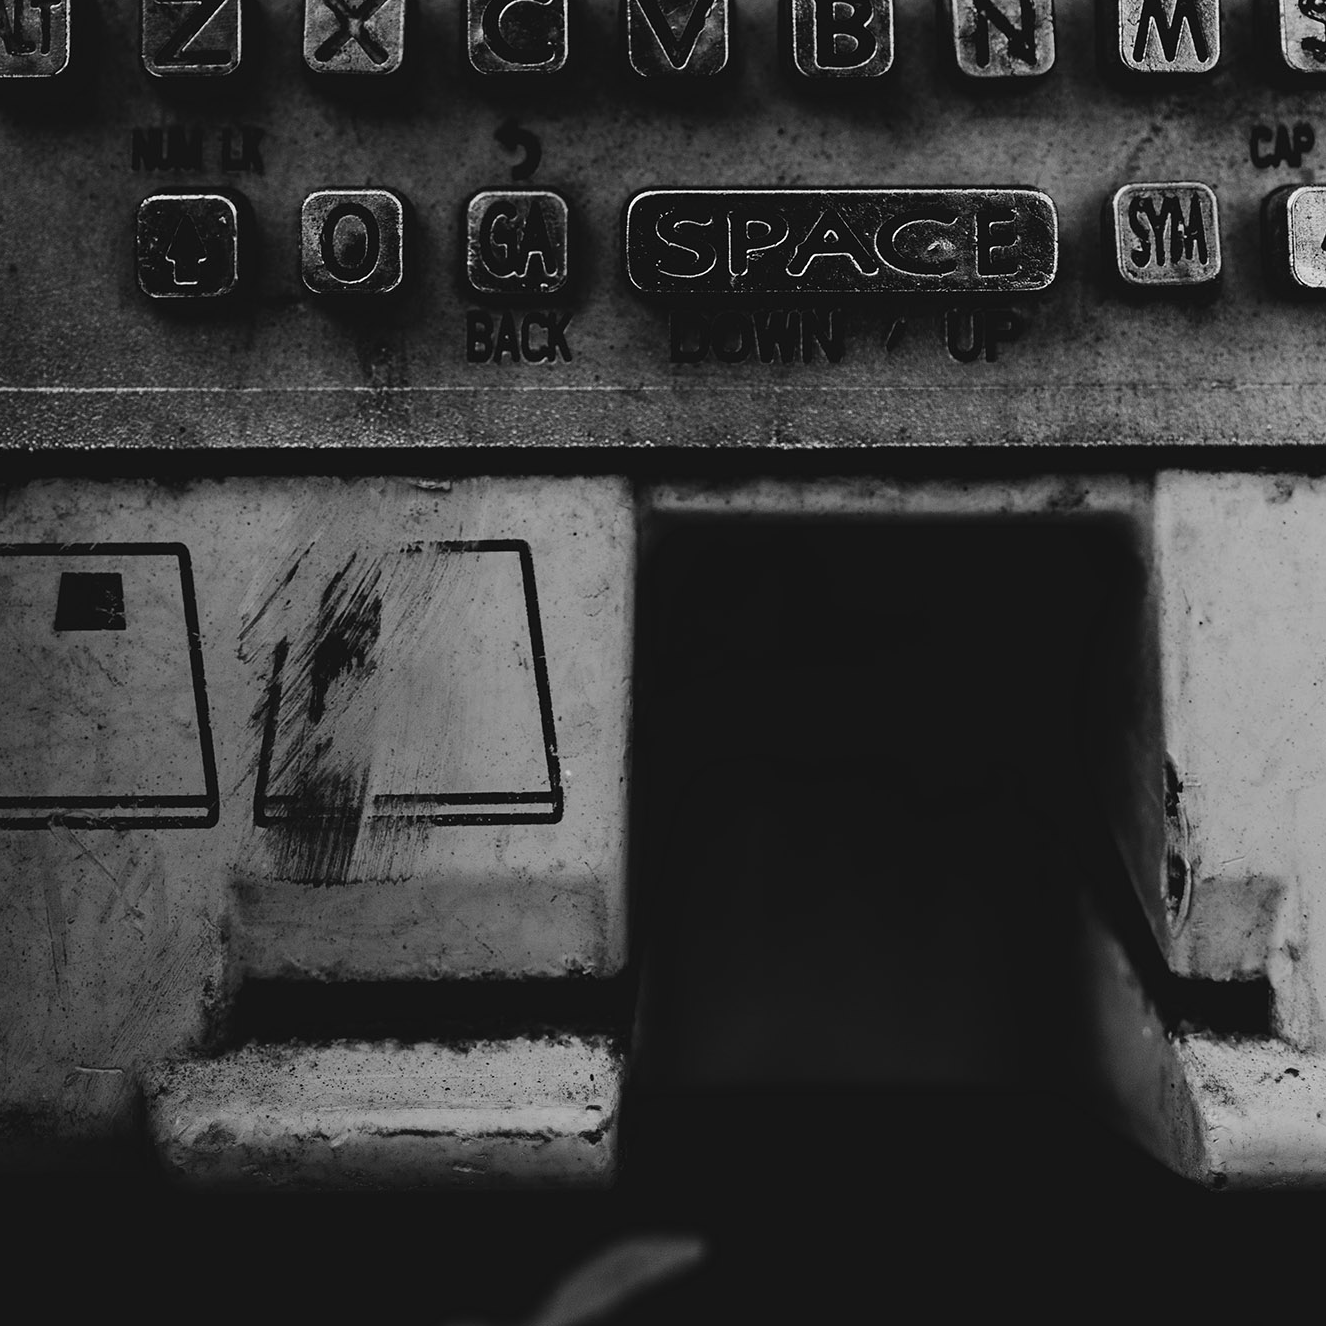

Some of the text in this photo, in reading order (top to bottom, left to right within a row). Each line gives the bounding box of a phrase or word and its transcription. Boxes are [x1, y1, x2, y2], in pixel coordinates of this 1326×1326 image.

[1250, 126, 1315, 169] CAP
[480, 200, 558, 278] GA
[655, 208, 1021, 278] SPACE
[1128, 196, 1206, 268] SYM
[466, 310, 572, 363] BACK
[669, 308, 843, 363] DOWN
[943, 308, 1022, 363] UP
